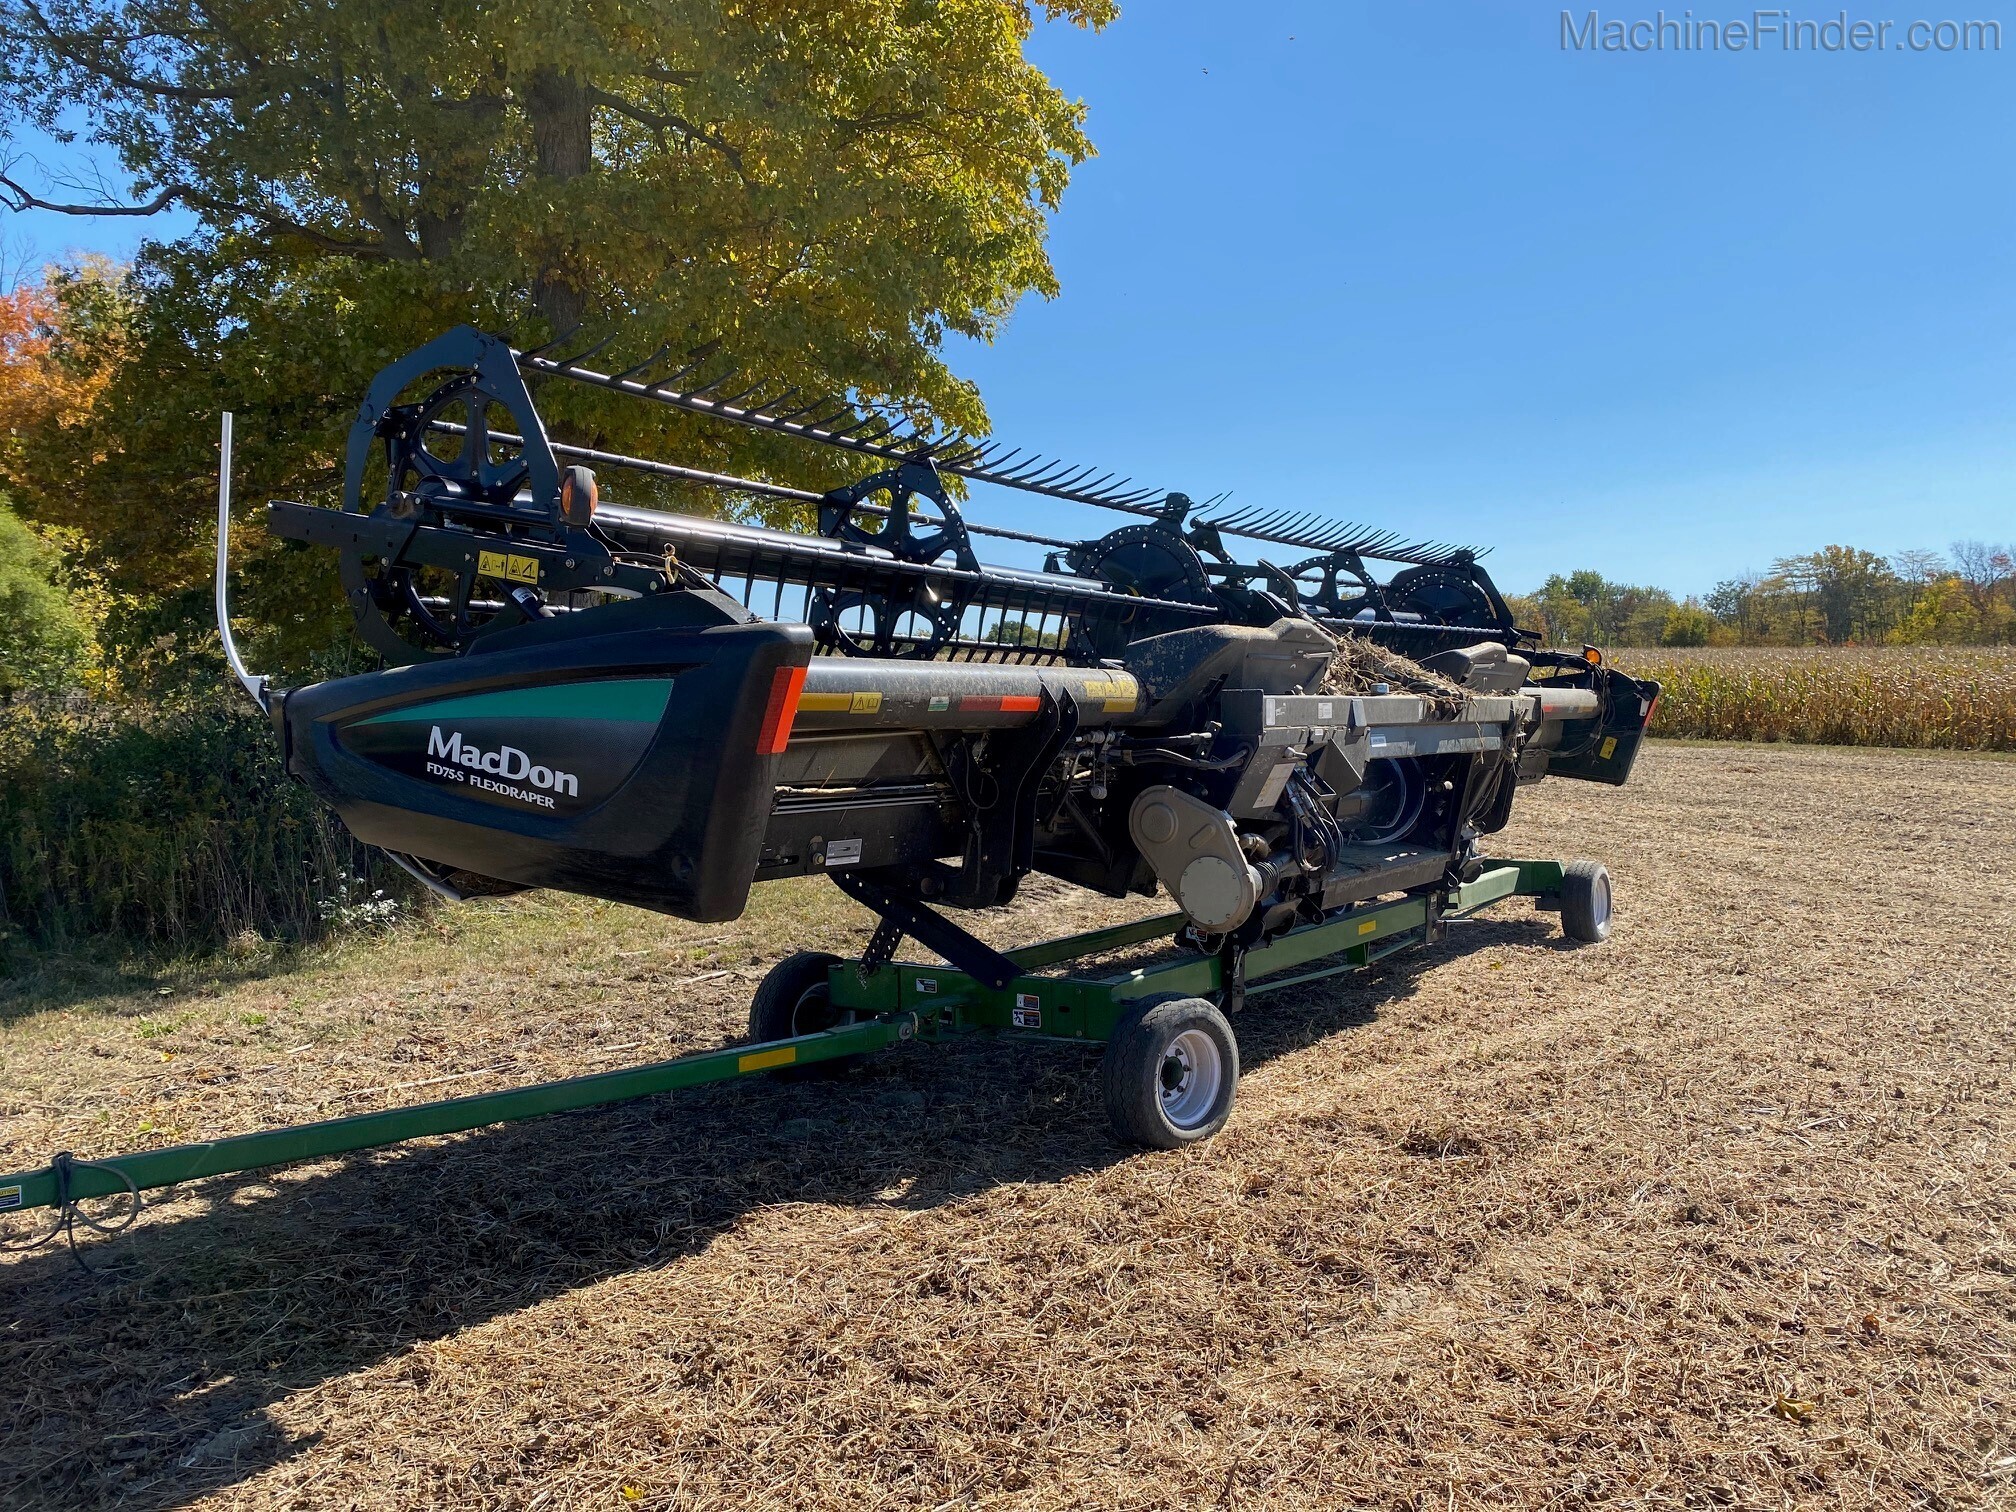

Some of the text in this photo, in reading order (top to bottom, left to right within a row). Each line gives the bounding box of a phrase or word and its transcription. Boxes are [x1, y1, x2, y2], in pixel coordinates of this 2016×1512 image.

[426, 761, 556, 810] FD75-S FLEXDRAPER
[427, 725, 579, 798] MacDon
